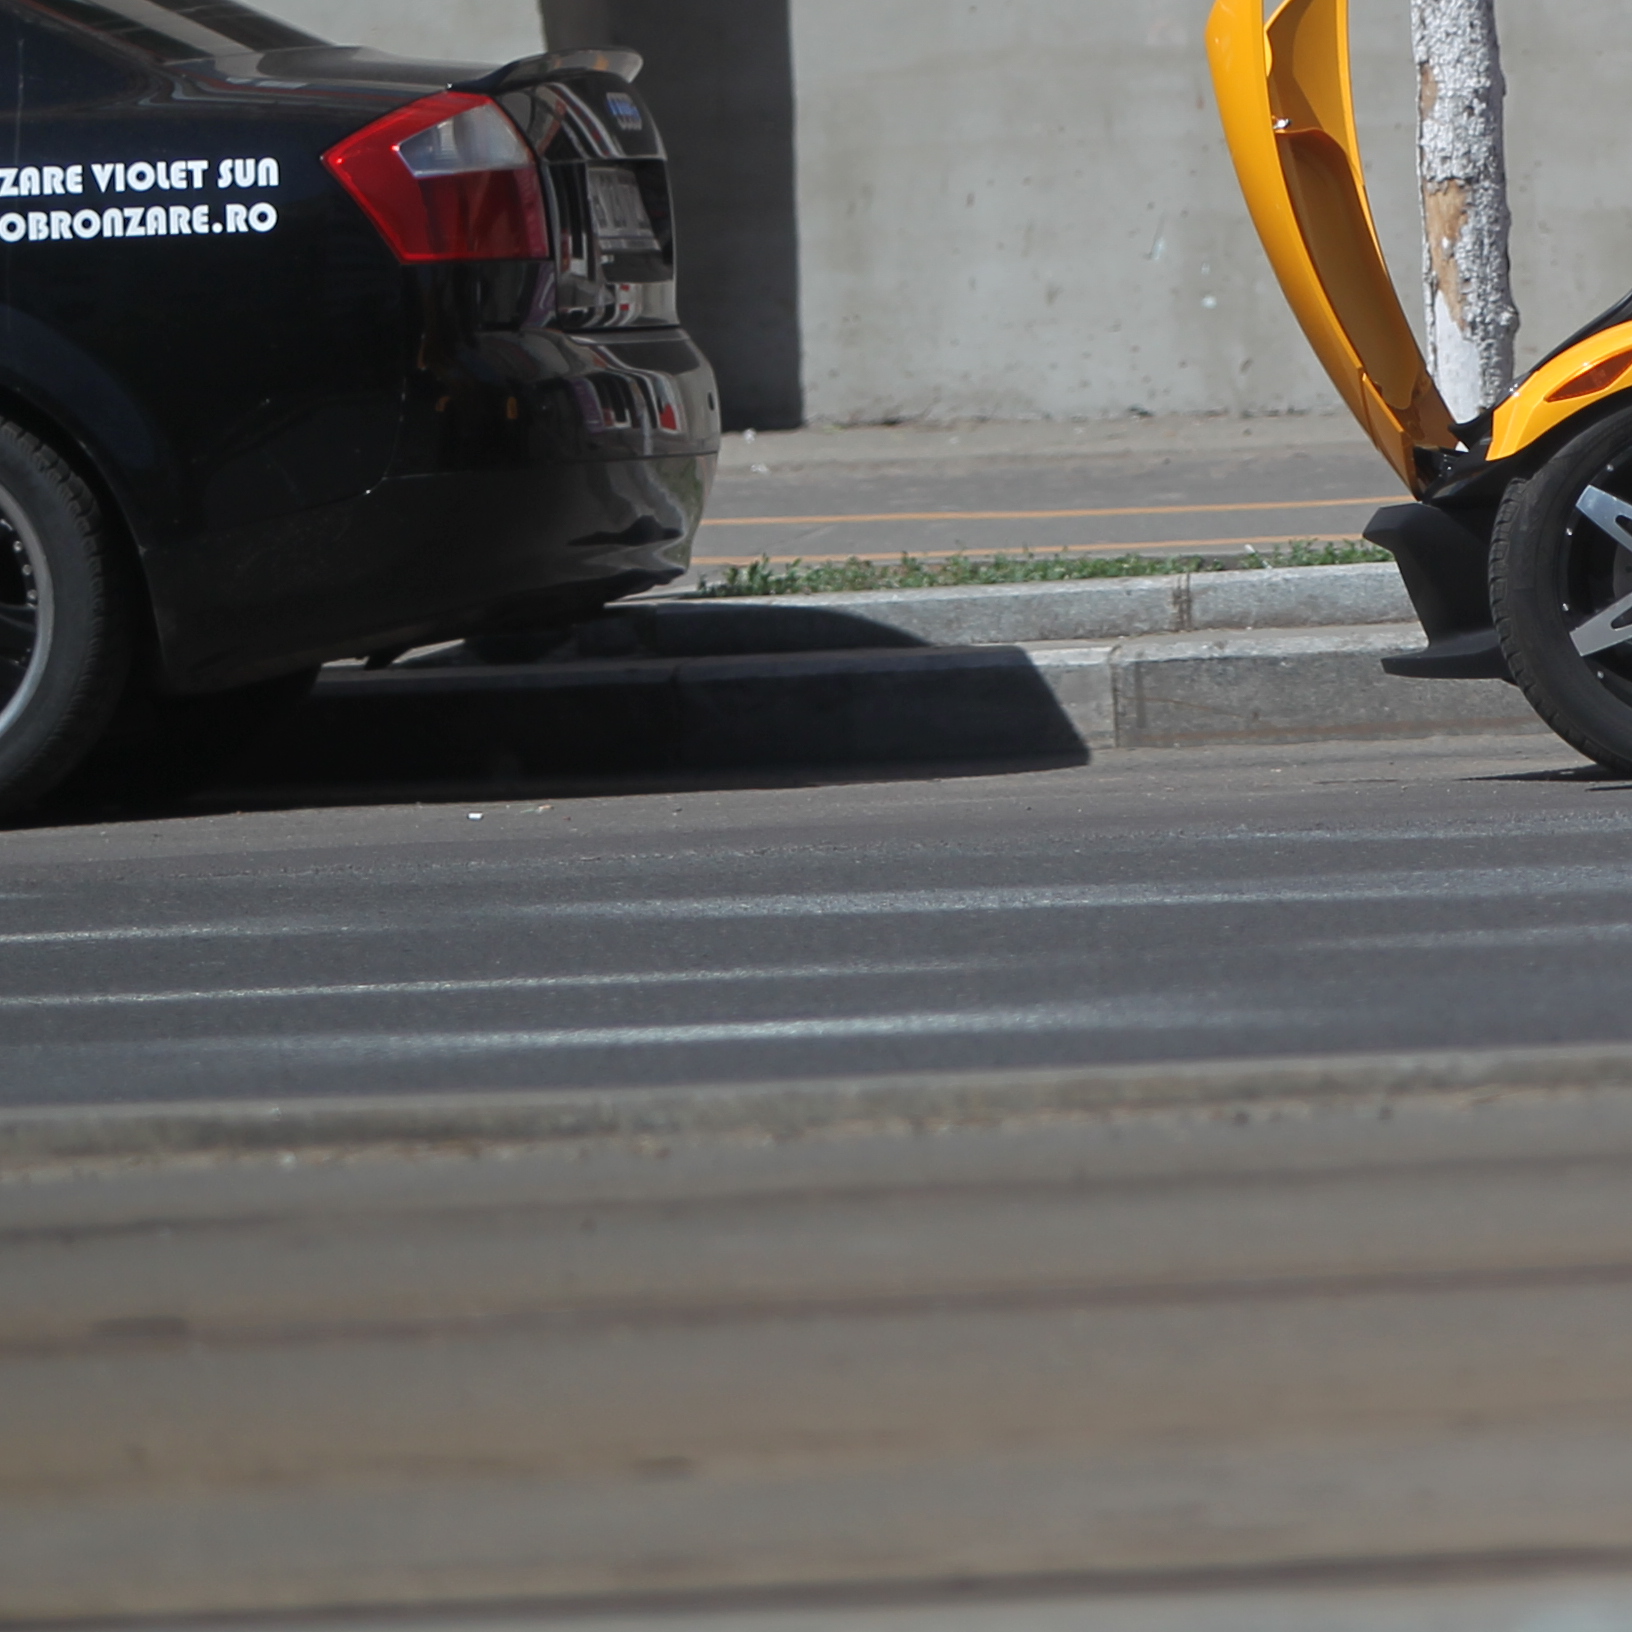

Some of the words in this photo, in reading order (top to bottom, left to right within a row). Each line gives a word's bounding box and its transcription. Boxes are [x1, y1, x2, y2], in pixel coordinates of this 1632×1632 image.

[0, 164, 83, 197] ZARE
[91, 159, 209, 193] VIOLET
[217, 157, 280, 188] SUN
[0, 201, 278, 243] OBRONZARE.RO
